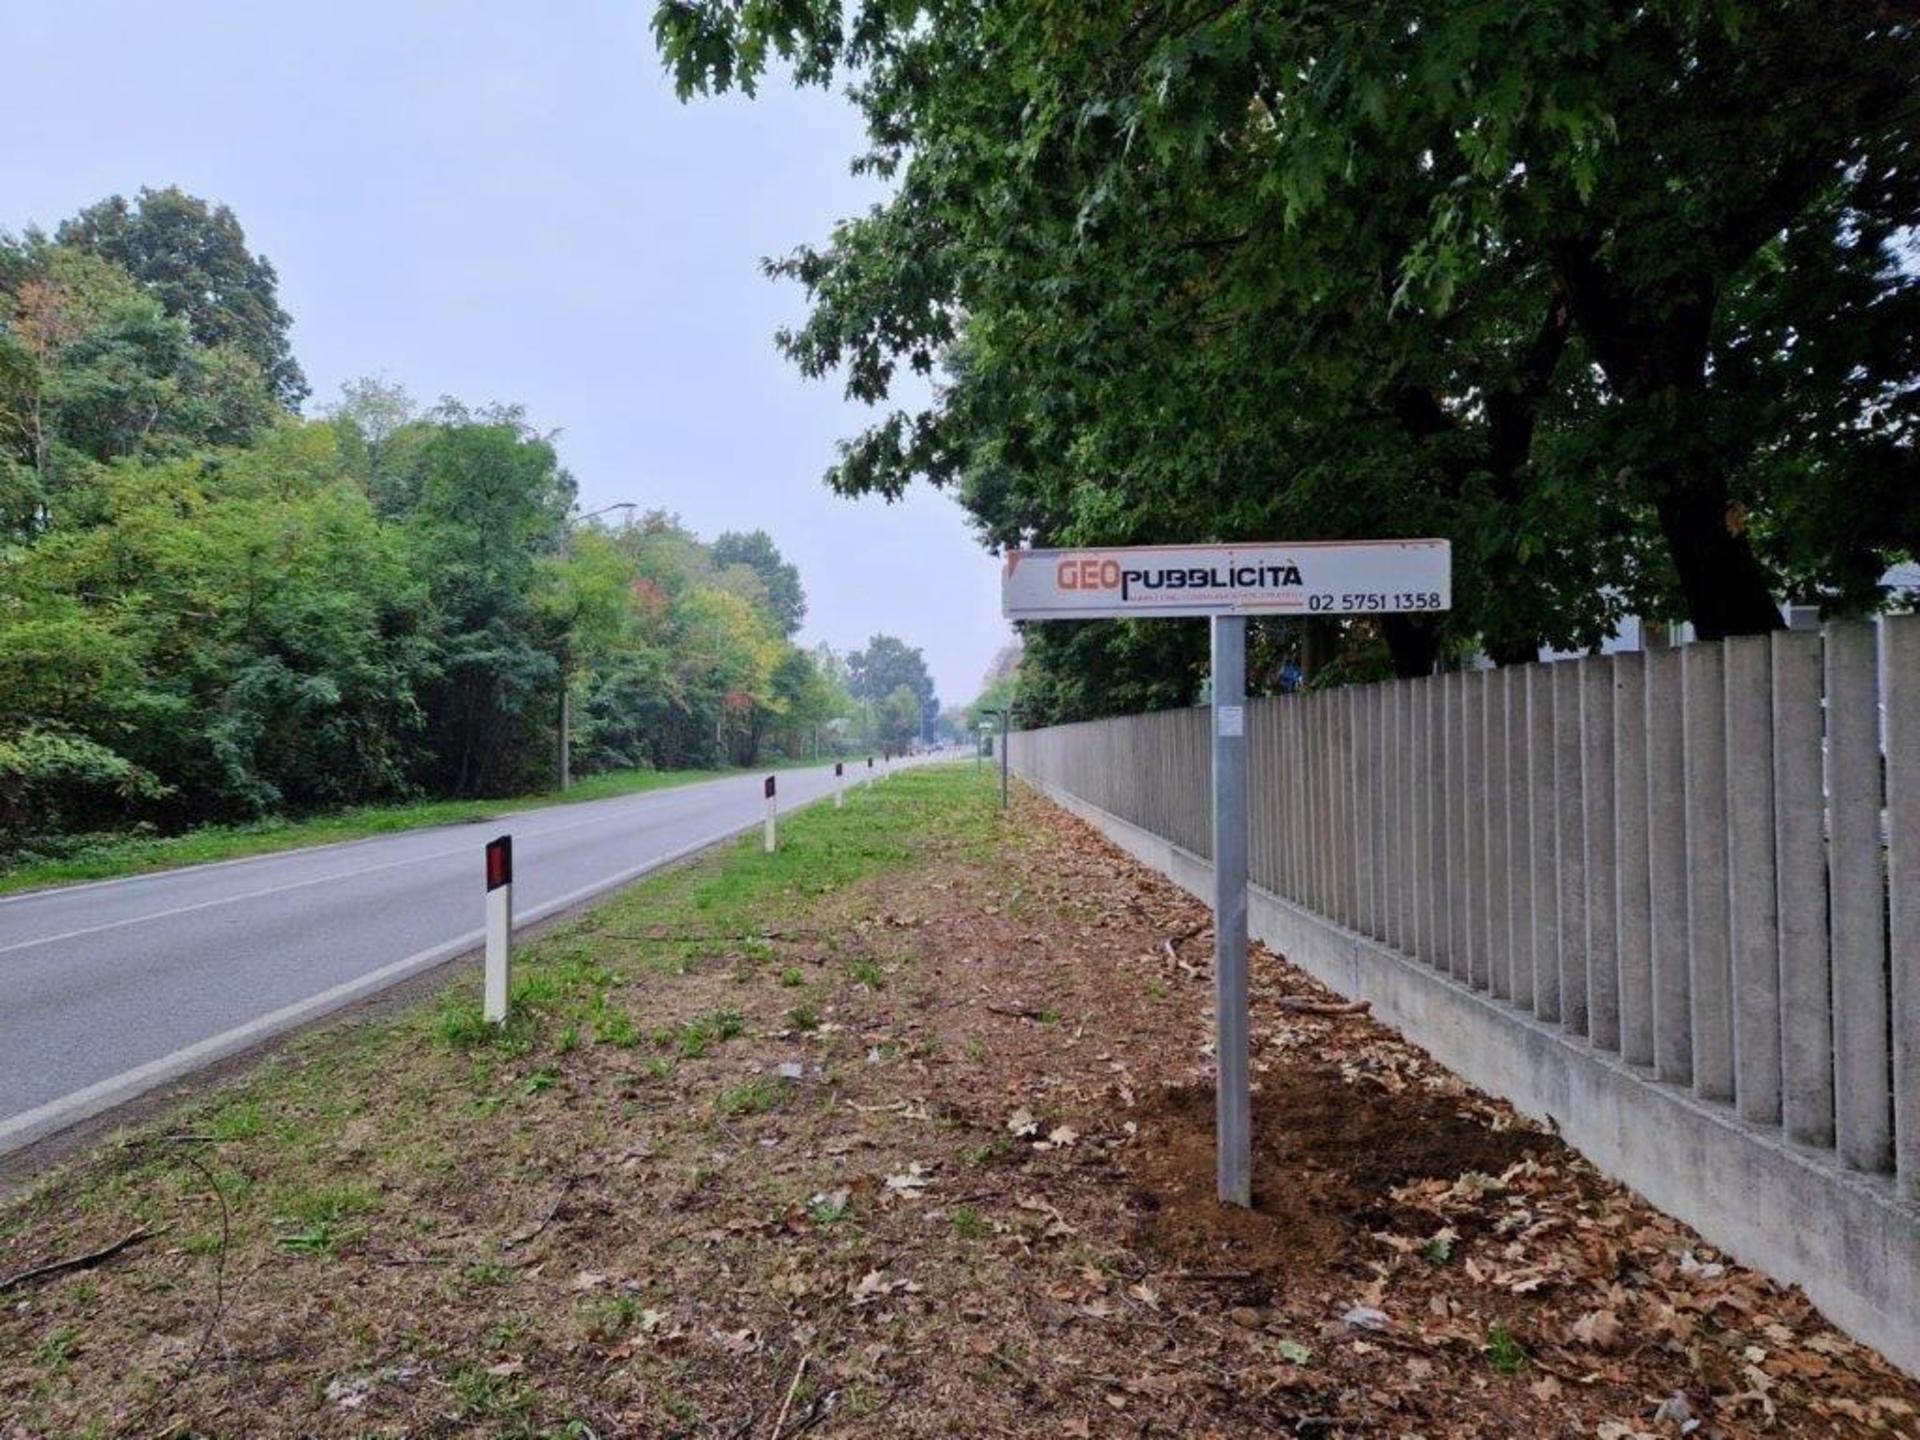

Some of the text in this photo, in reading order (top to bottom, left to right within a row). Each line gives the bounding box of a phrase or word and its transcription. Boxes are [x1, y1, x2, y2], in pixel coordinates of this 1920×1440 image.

[1308, 594, 1335, 611] 02
[1341, 593, 1387, 610] 5751
[1393, 592, 1441, 609] 1358
